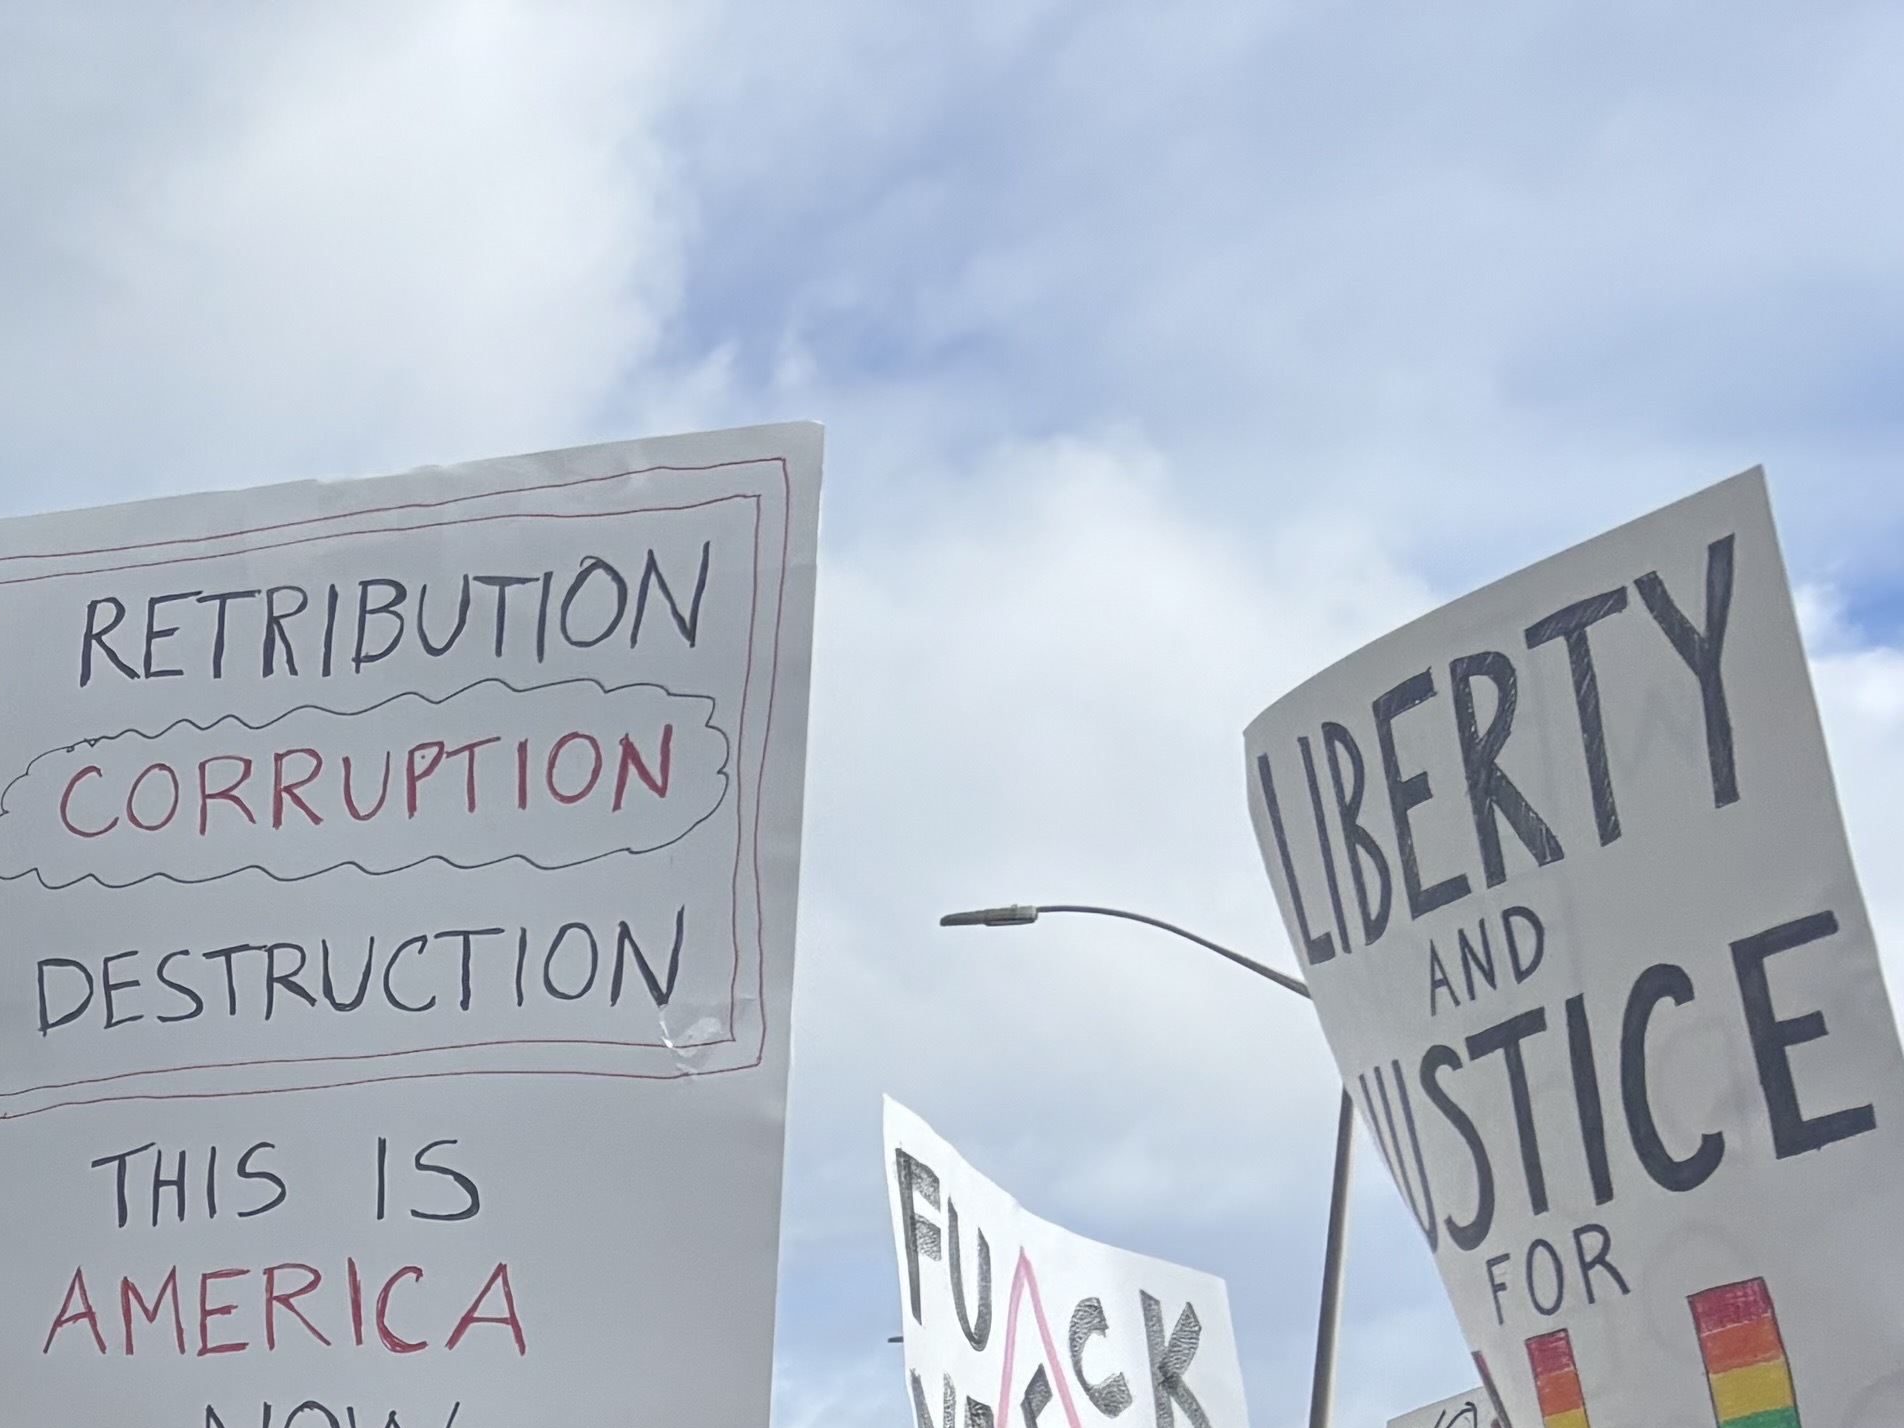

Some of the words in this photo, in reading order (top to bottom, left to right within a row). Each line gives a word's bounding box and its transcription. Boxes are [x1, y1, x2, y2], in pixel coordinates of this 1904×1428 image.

[78, 540, 714, 688] RETRIBUTION
[59, 723, 674, 838] CORRUPTION
[1258, 532, 1739, 966] LIBERTY
[36, 906, 688, 1037] DESTRUCTION
[1426, 904, 1549, 1016] AND
[91, 1140, 287, 1228] THIS
[375, 1136, 481, 1222] IS
[42, 1255, 528, 1358] AMERICA
[1487, 1223, 1630, 1326] FOR
